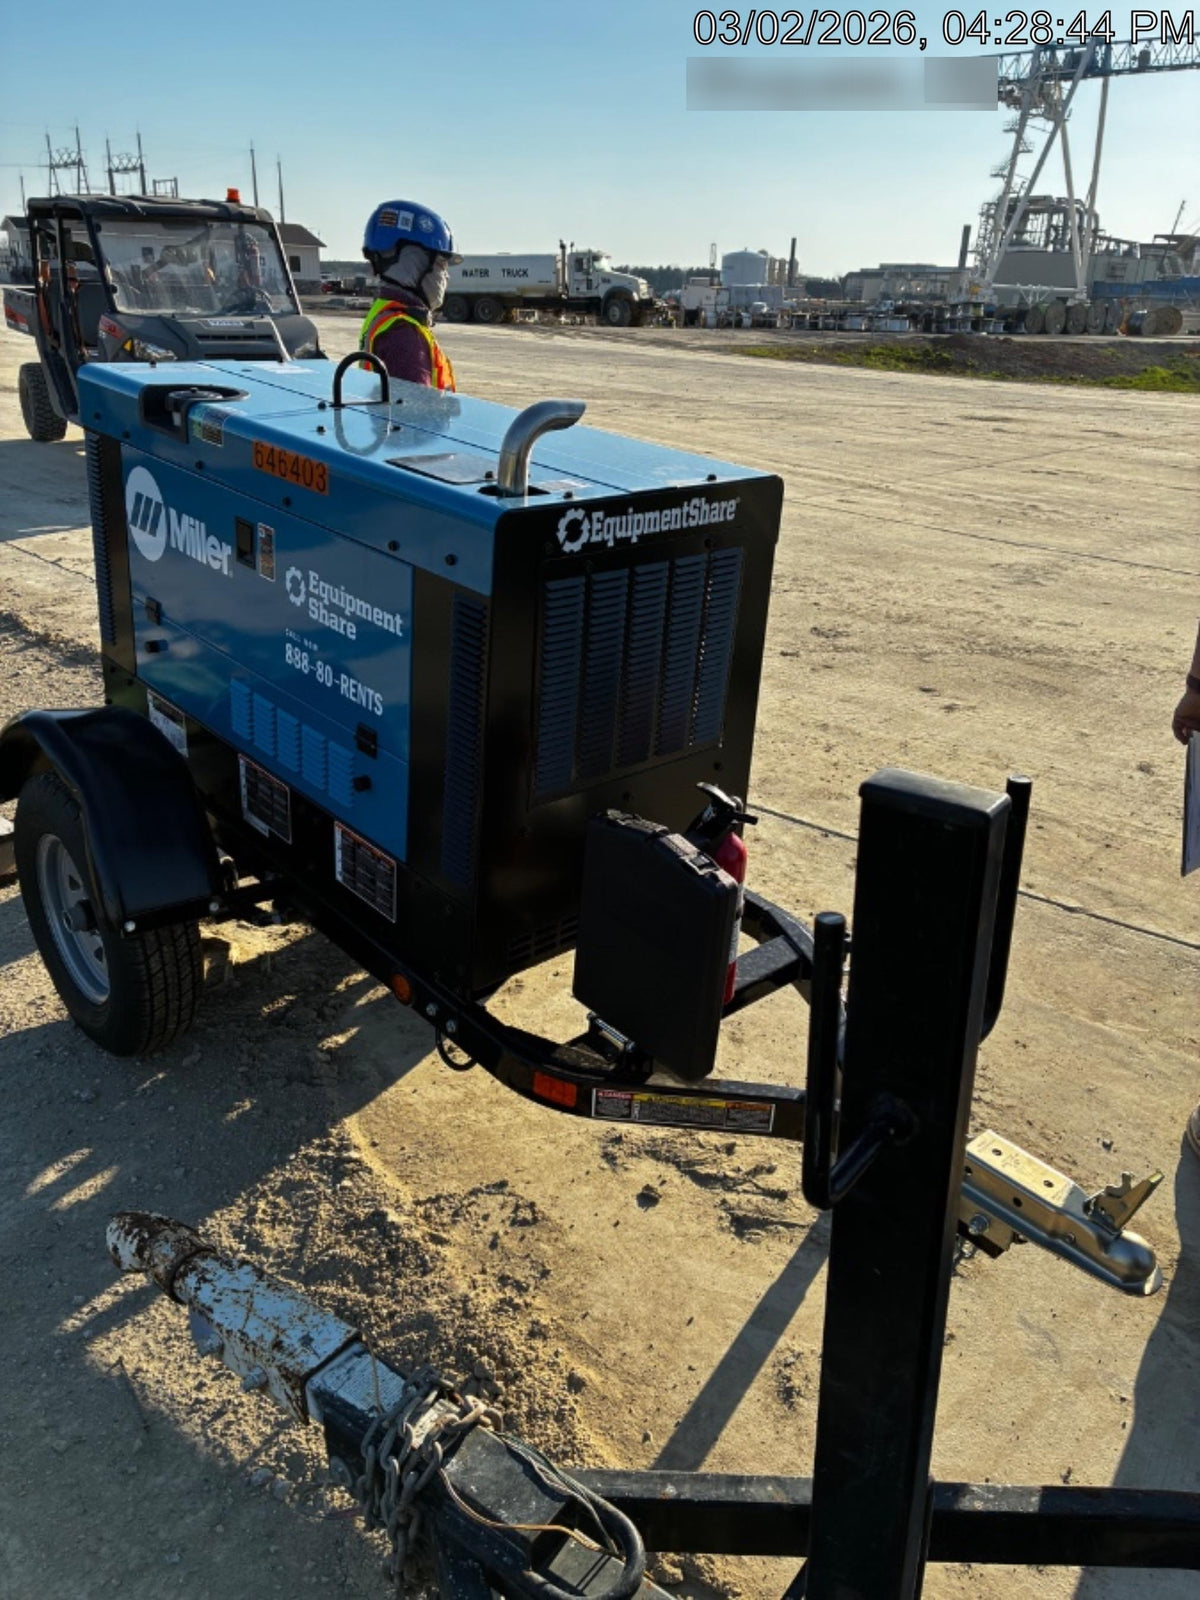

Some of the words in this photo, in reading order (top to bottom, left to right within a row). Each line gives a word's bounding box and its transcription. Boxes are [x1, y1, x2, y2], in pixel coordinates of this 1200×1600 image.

[462, 268, 490, 278] WATER
[501, 268, 529, 278] TRUCK
[254, 441, 327, 492] 646403
[168, 506, 232, 575] Miller
[590, 497, 737, 547] EquipmentShare
[308, 569, 403, 637] Equipment
[308, 597, 357, 641] Share
[285, 642, 383, 716] 888-80-RENTS
